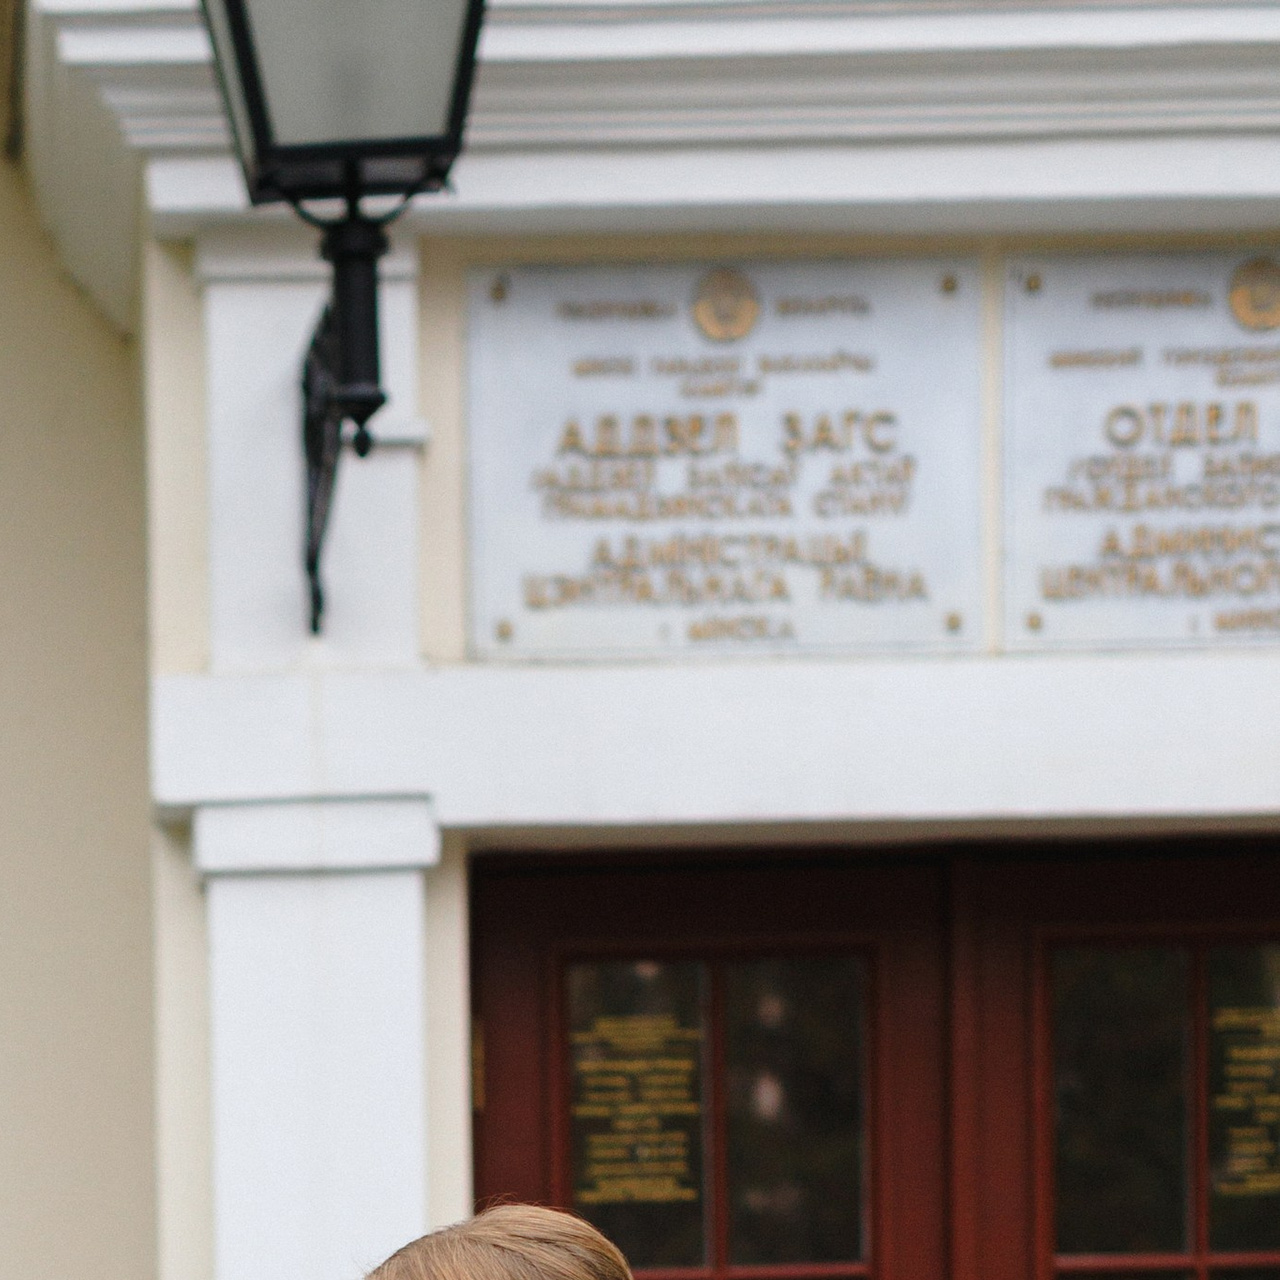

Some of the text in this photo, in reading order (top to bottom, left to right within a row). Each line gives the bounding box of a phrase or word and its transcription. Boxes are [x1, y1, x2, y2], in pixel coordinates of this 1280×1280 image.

[556, 409, 897, 457] АДДЗЕЛ ЗАГС
[1103, 402, 1258, 447] ОТДЕЛ
